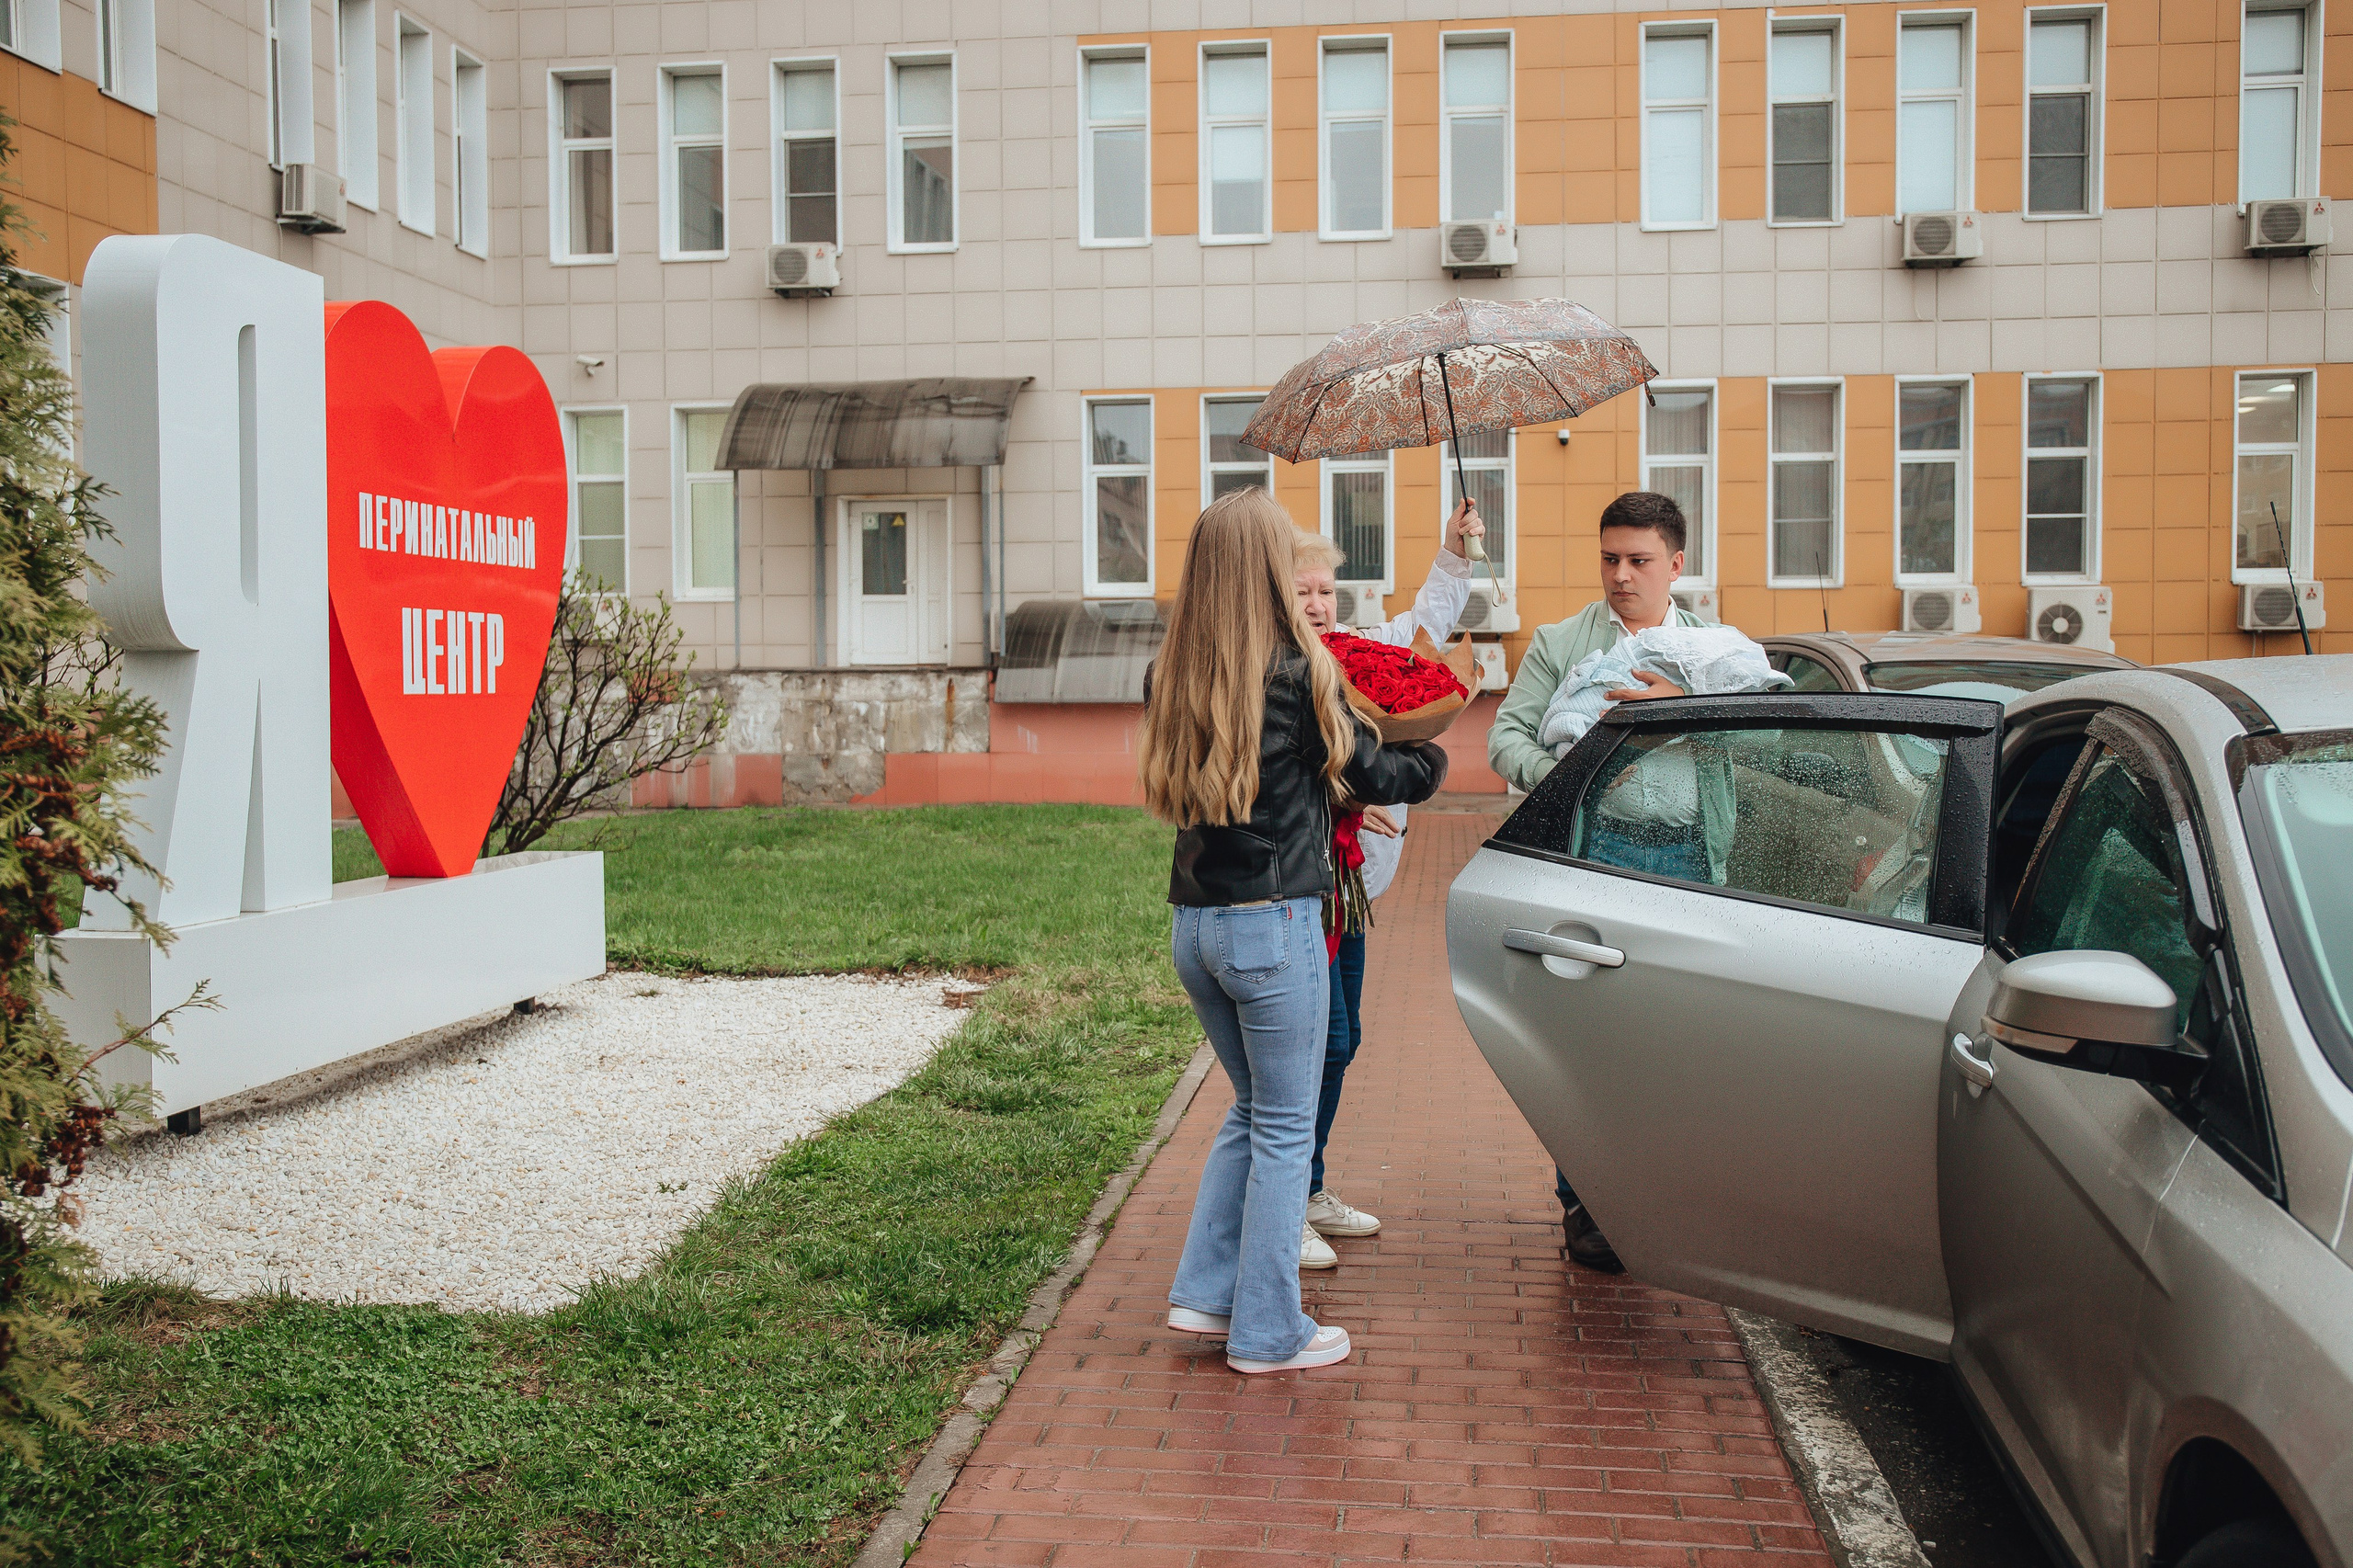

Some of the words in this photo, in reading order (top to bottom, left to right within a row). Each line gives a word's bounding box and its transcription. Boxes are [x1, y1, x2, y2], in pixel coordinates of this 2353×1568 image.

[358, 491, 536, 570] ПЕРИНАТАЛЬНЫЙ
[81, 233, 333, 930] Я
[402, 607, 505, 695] ЦЕНТР
